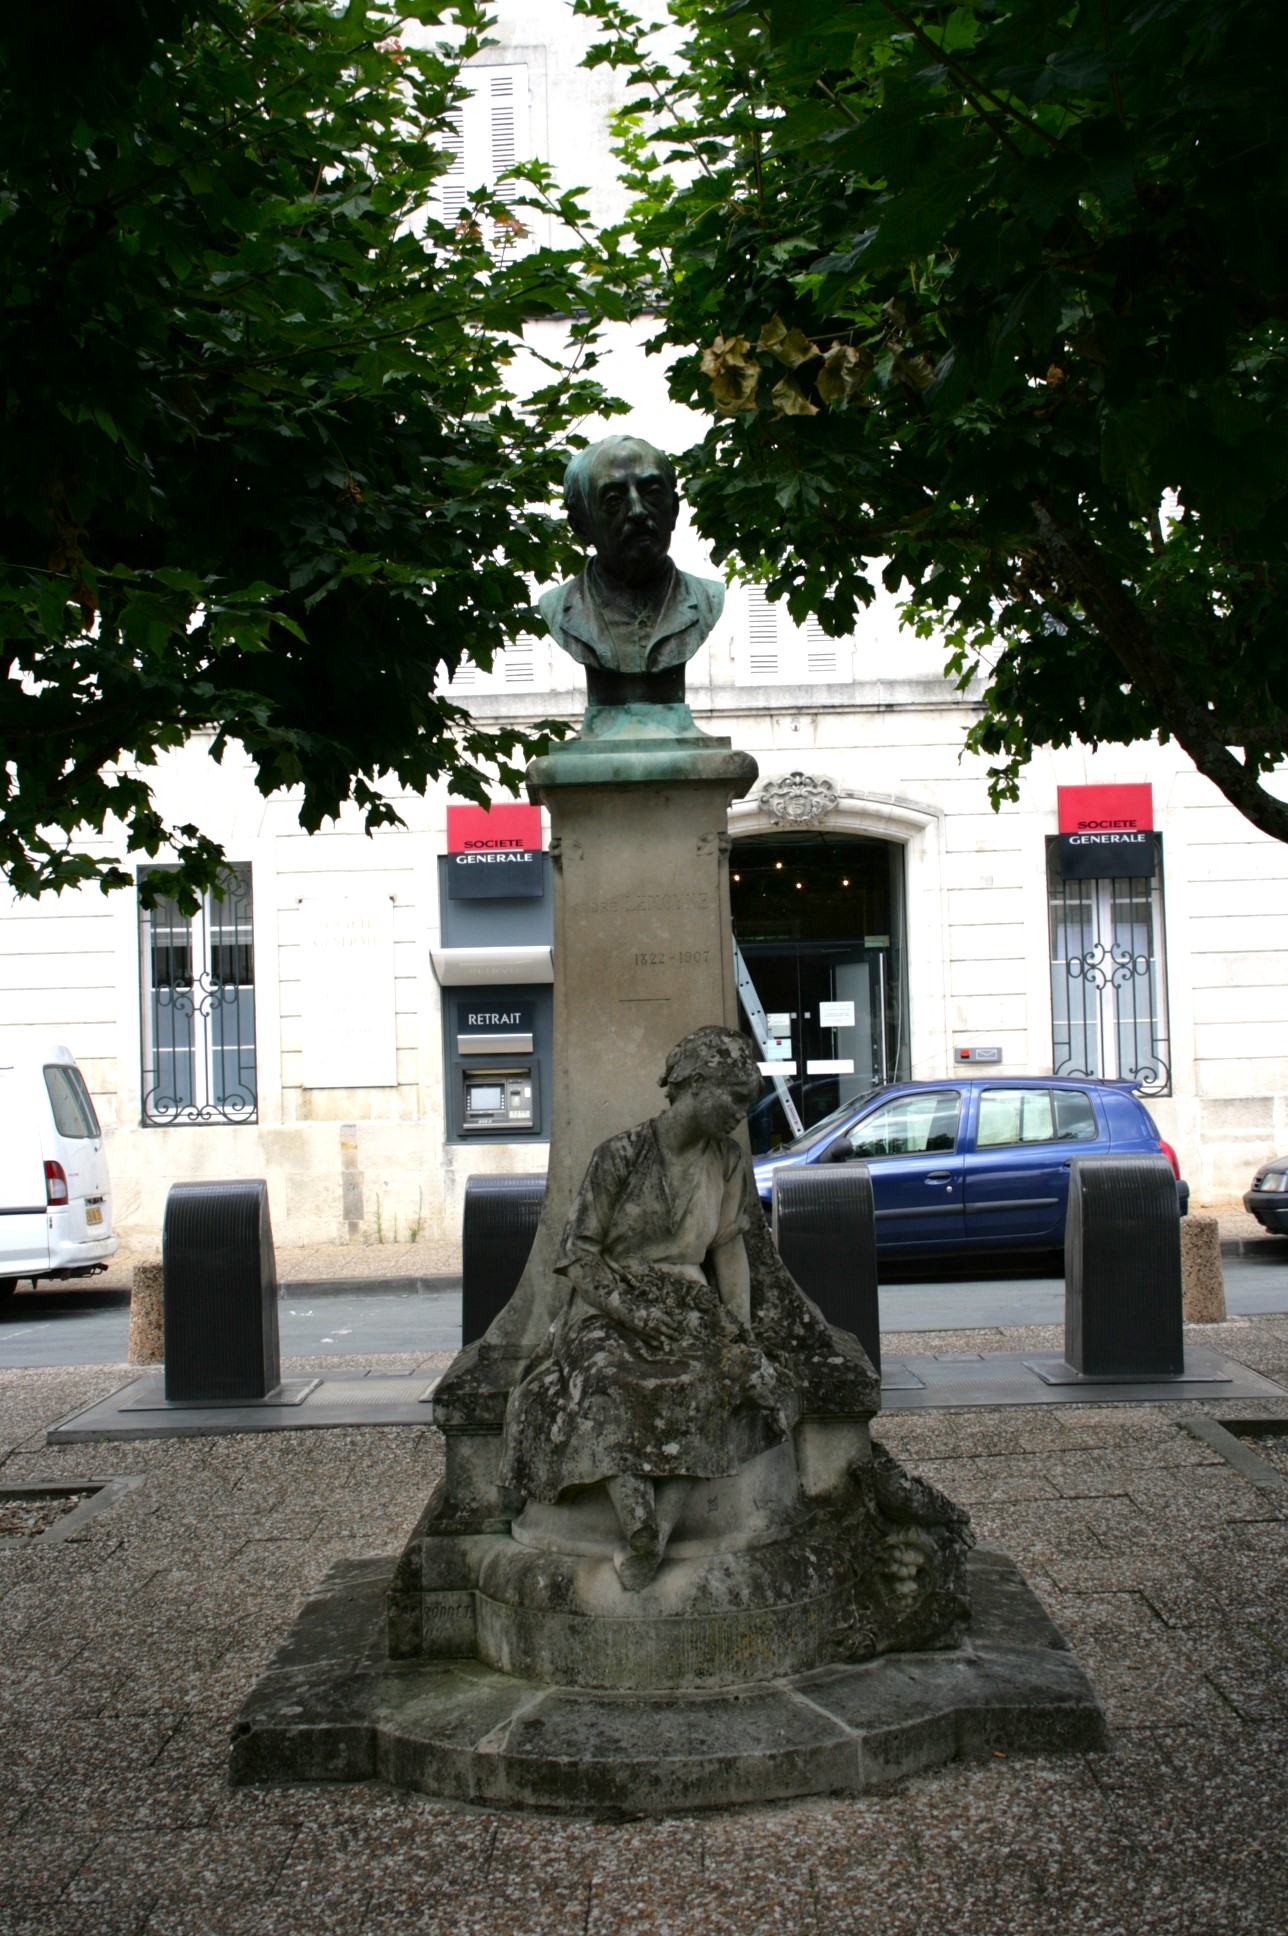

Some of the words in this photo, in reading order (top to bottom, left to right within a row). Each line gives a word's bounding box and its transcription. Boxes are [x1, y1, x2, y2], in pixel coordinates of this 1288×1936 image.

[1078, 819, 1137, 829] SOCIETE
[464, 839, 524, 850] SOCIETE
[1069, 833, 1146, 845] GENERALE
[456, 853, 533, 865] GENERALE
[634, 952, 666, 966] 1822
[679, 950, 710, 964] 1907
[468, 1012, 522, 1026] RETRAIT
